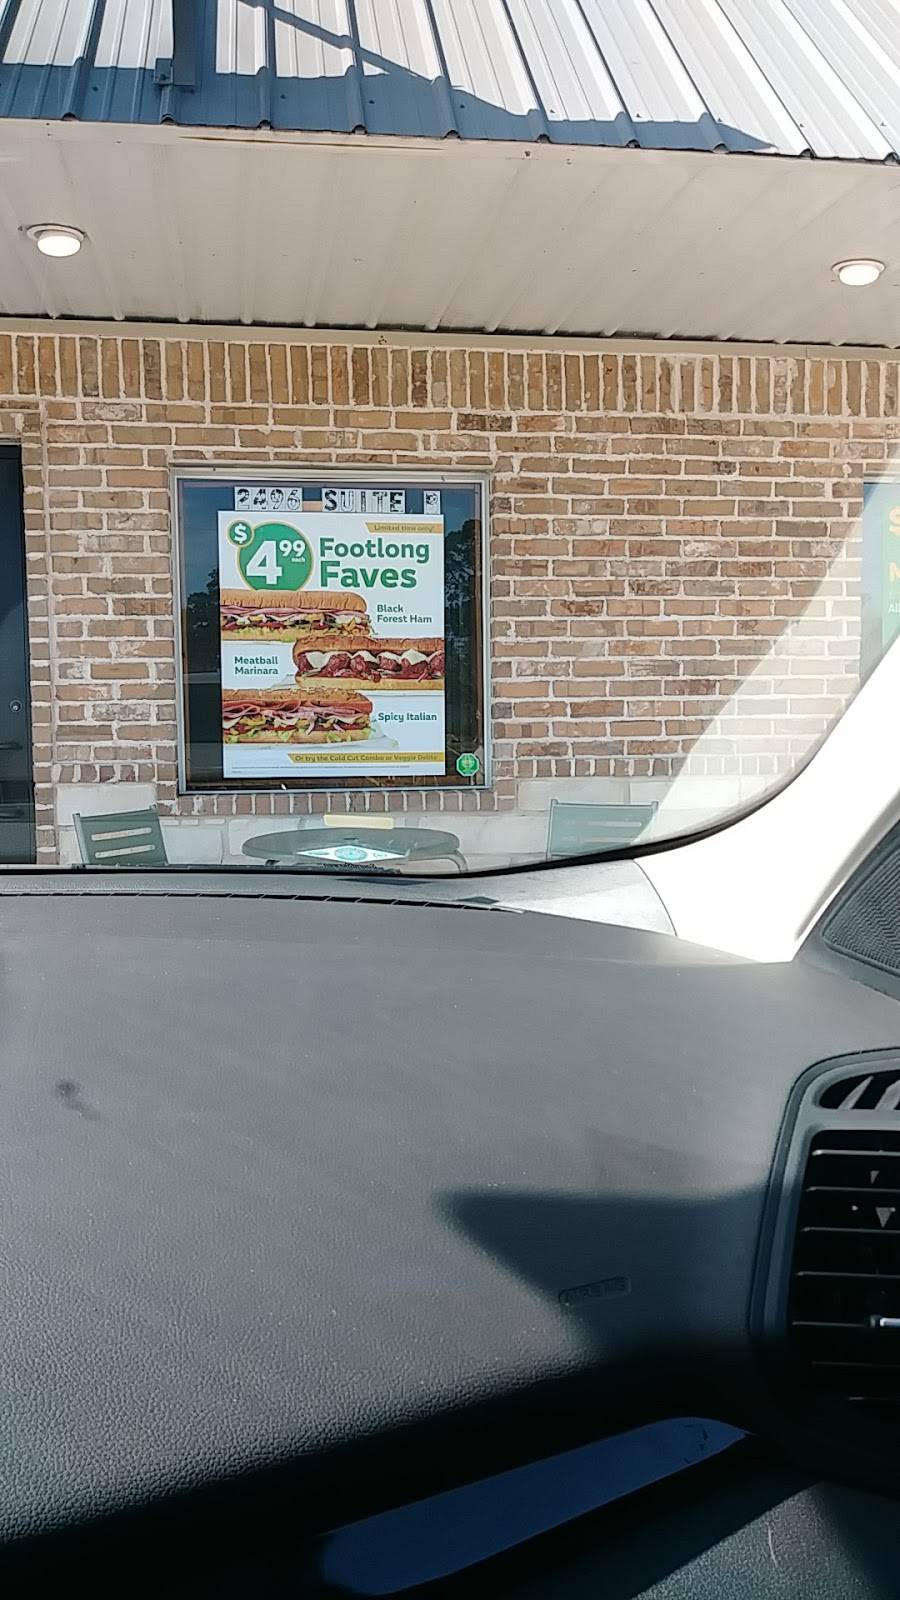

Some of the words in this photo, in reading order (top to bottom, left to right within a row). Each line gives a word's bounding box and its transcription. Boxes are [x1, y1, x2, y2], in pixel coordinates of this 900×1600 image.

[237, 488, 301, 511] 2496
[324, 489, 404, 513] SUITE
[234, 523, 248, 544] $
[319, 537, 430, 564] Footlong
[320, 560, 417, 588] Faves
[377, 604, 404, 613] Black
[377, 614, 408, 623] Forest
[410, 614, 433, 623] Ham
[234, 656, 279, 665] Meatball
[234, 666, 279, 675] Marinara
[378, 711, 404, 723] Spicy
[406, 712, 437, 721] Italian
[305, 755, 316, 763] try
